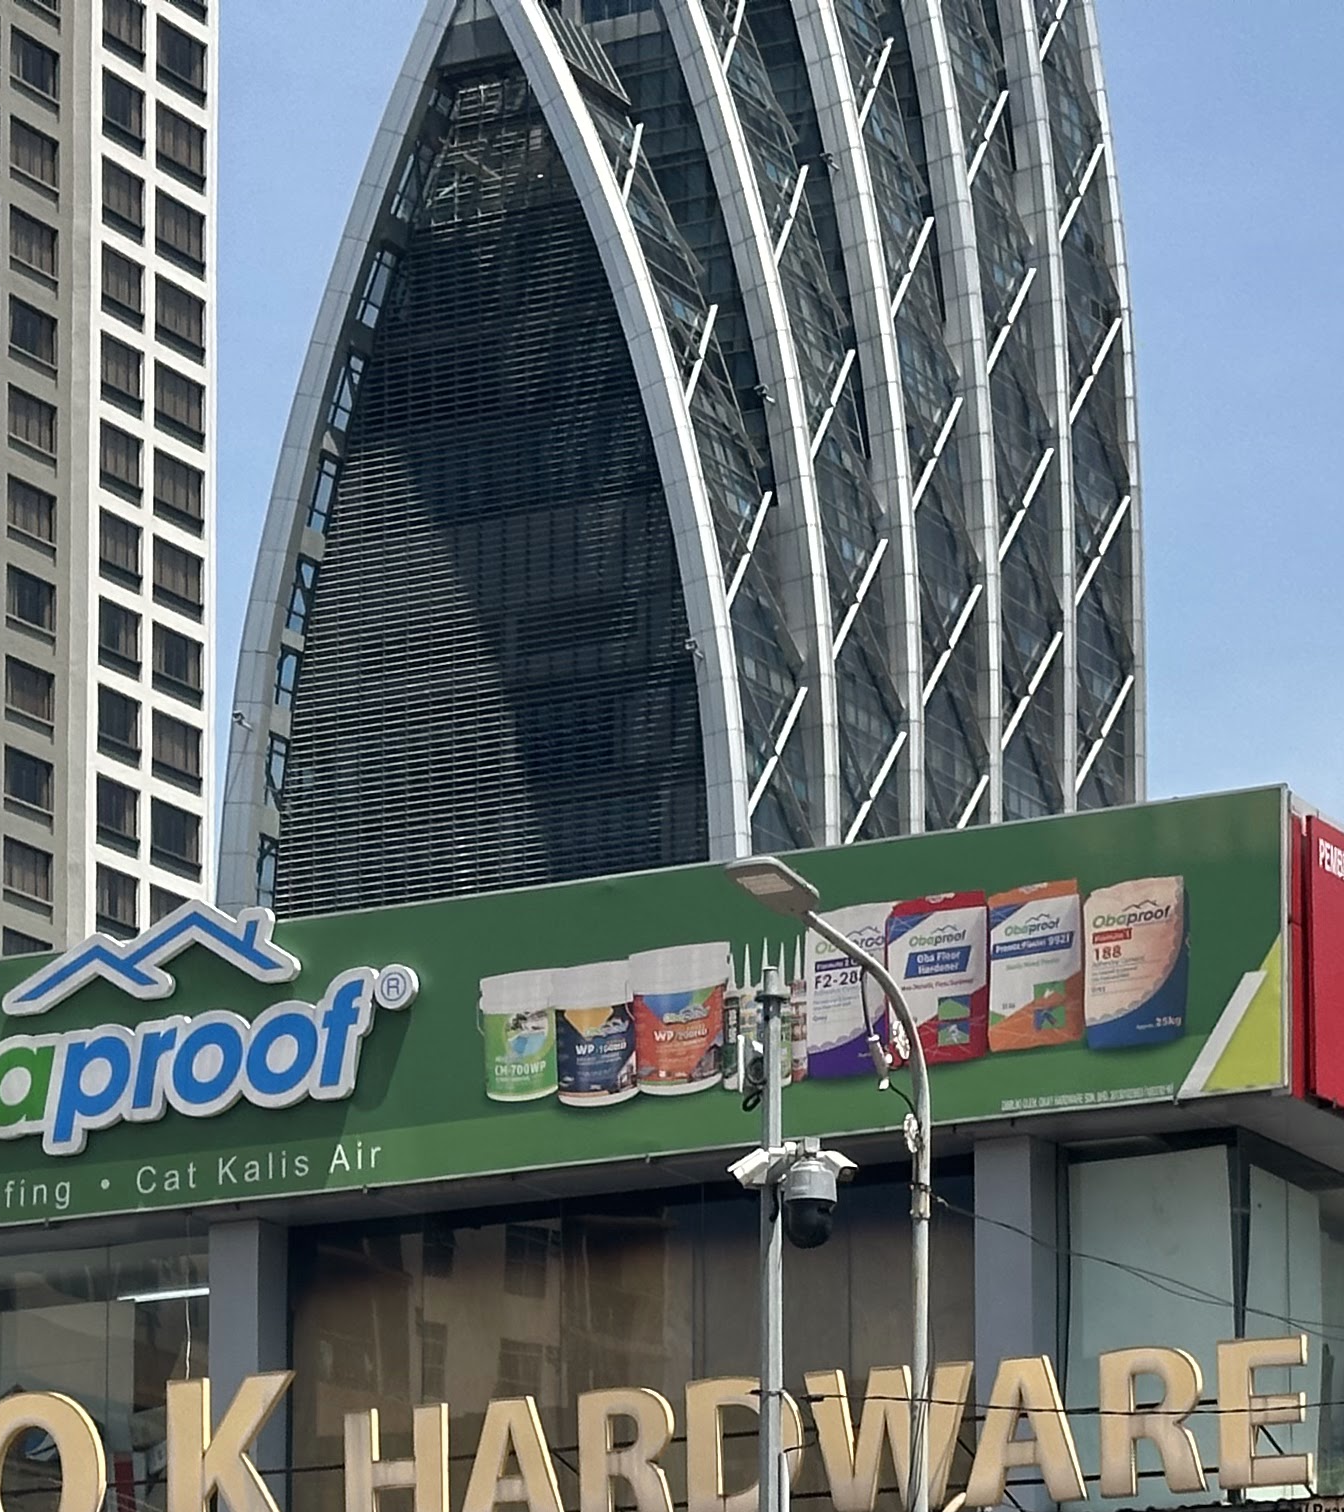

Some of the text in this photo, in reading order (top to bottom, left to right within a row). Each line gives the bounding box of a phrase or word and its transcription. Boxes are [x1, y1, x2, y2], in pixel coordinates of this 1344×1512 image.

[1093, 904, 1171, 929] Obaproof
[1005, 918, 1060, 937] Obaproof
[909, 932, 966, 948] Obaproof
[1094, 945, 1123, 961] 188
[814, 971, 863, 990] F2-28
[136, 1165, 197, 1195] Cat
[217, 1151, 310, 1185] Kalis
[328, 1142, 382, 1172] Air
